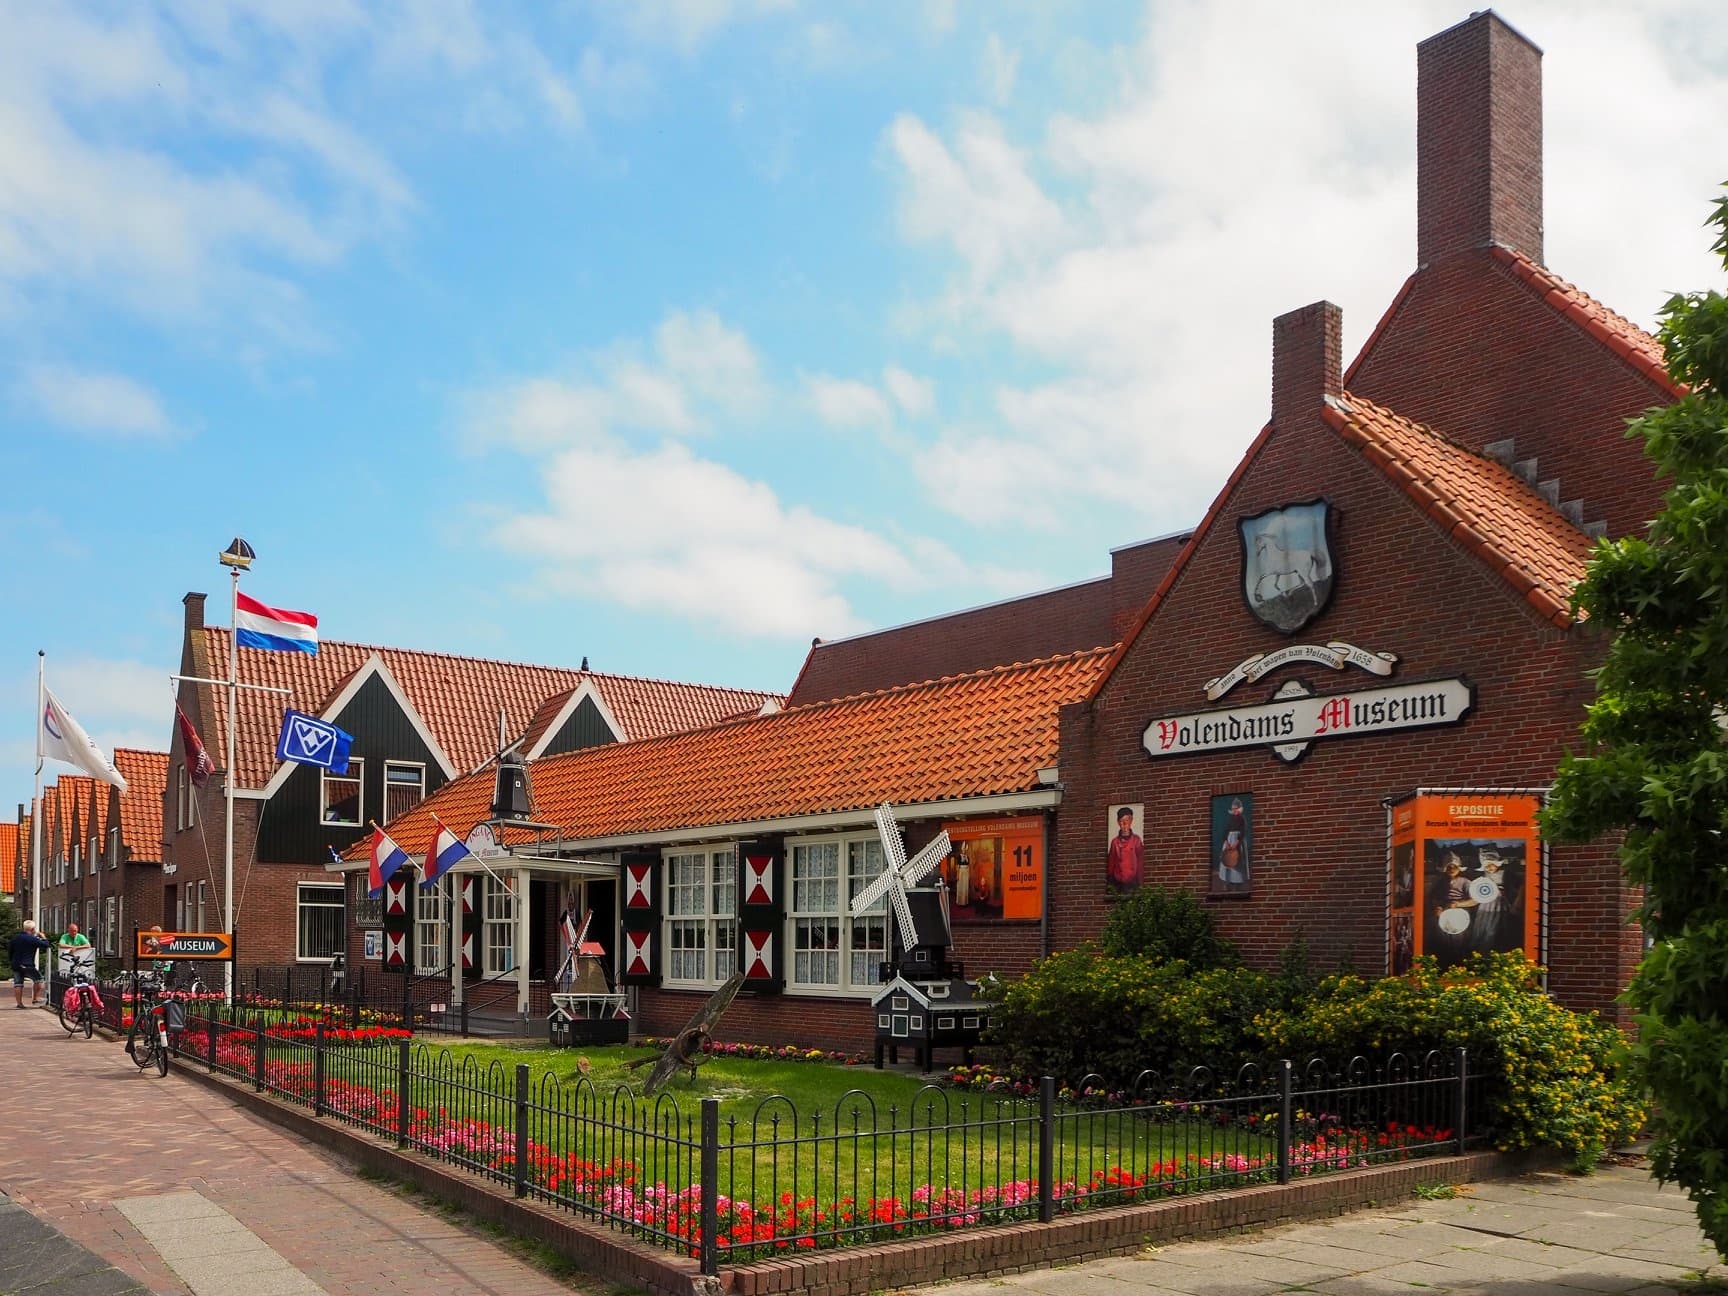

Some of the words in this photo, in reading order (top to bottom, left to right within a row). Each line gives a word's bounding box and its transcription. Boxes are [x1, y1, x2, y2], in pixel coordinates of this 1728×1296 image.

[1157, 709, 1295, 750] Volendams
[1314, 693, 1447, 734] Museum
[1449, 805, 1504, 815] EXPOSITIE
[1013, 845, 1032, 867] 11
[1009, 872, 1037, 884] miljoen
[169, 940, 215, 952] MUSEUM
